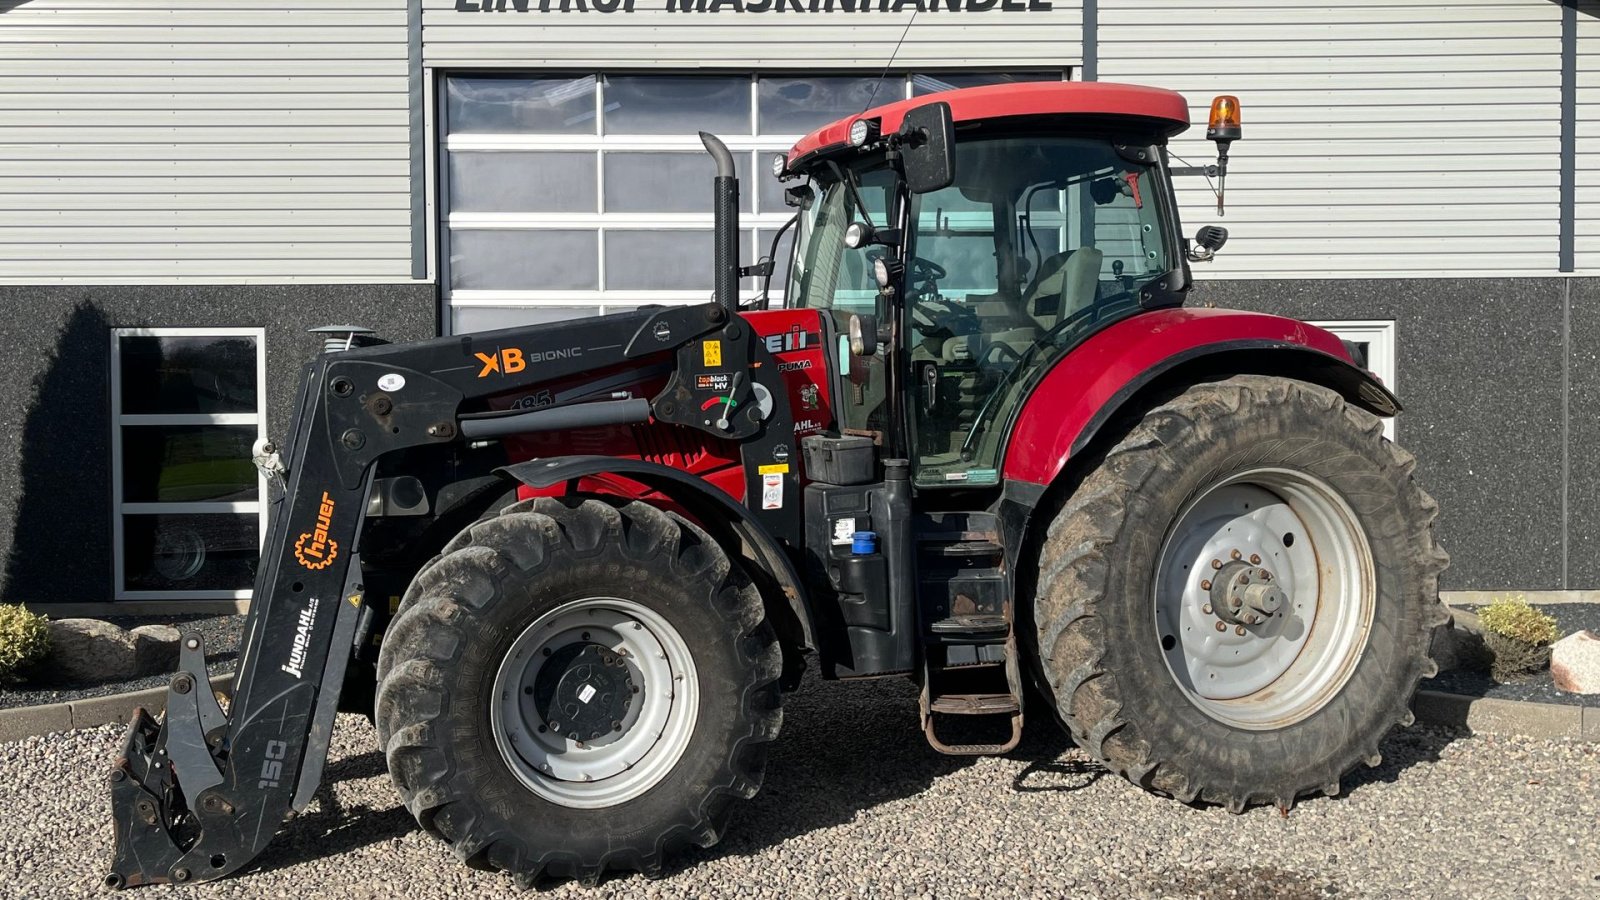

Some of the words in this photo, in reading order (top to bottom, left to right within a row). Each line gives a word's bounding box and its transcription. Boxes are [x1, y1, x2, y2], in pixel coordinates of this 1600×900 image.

[530, 347, 582, 362] BIONIC
[778, 360, 812, 372] PUMA
[714, 382, 728, 390] HV
[304, 491, 335, 558] hauer
[258, 740, 287, 789] 150
